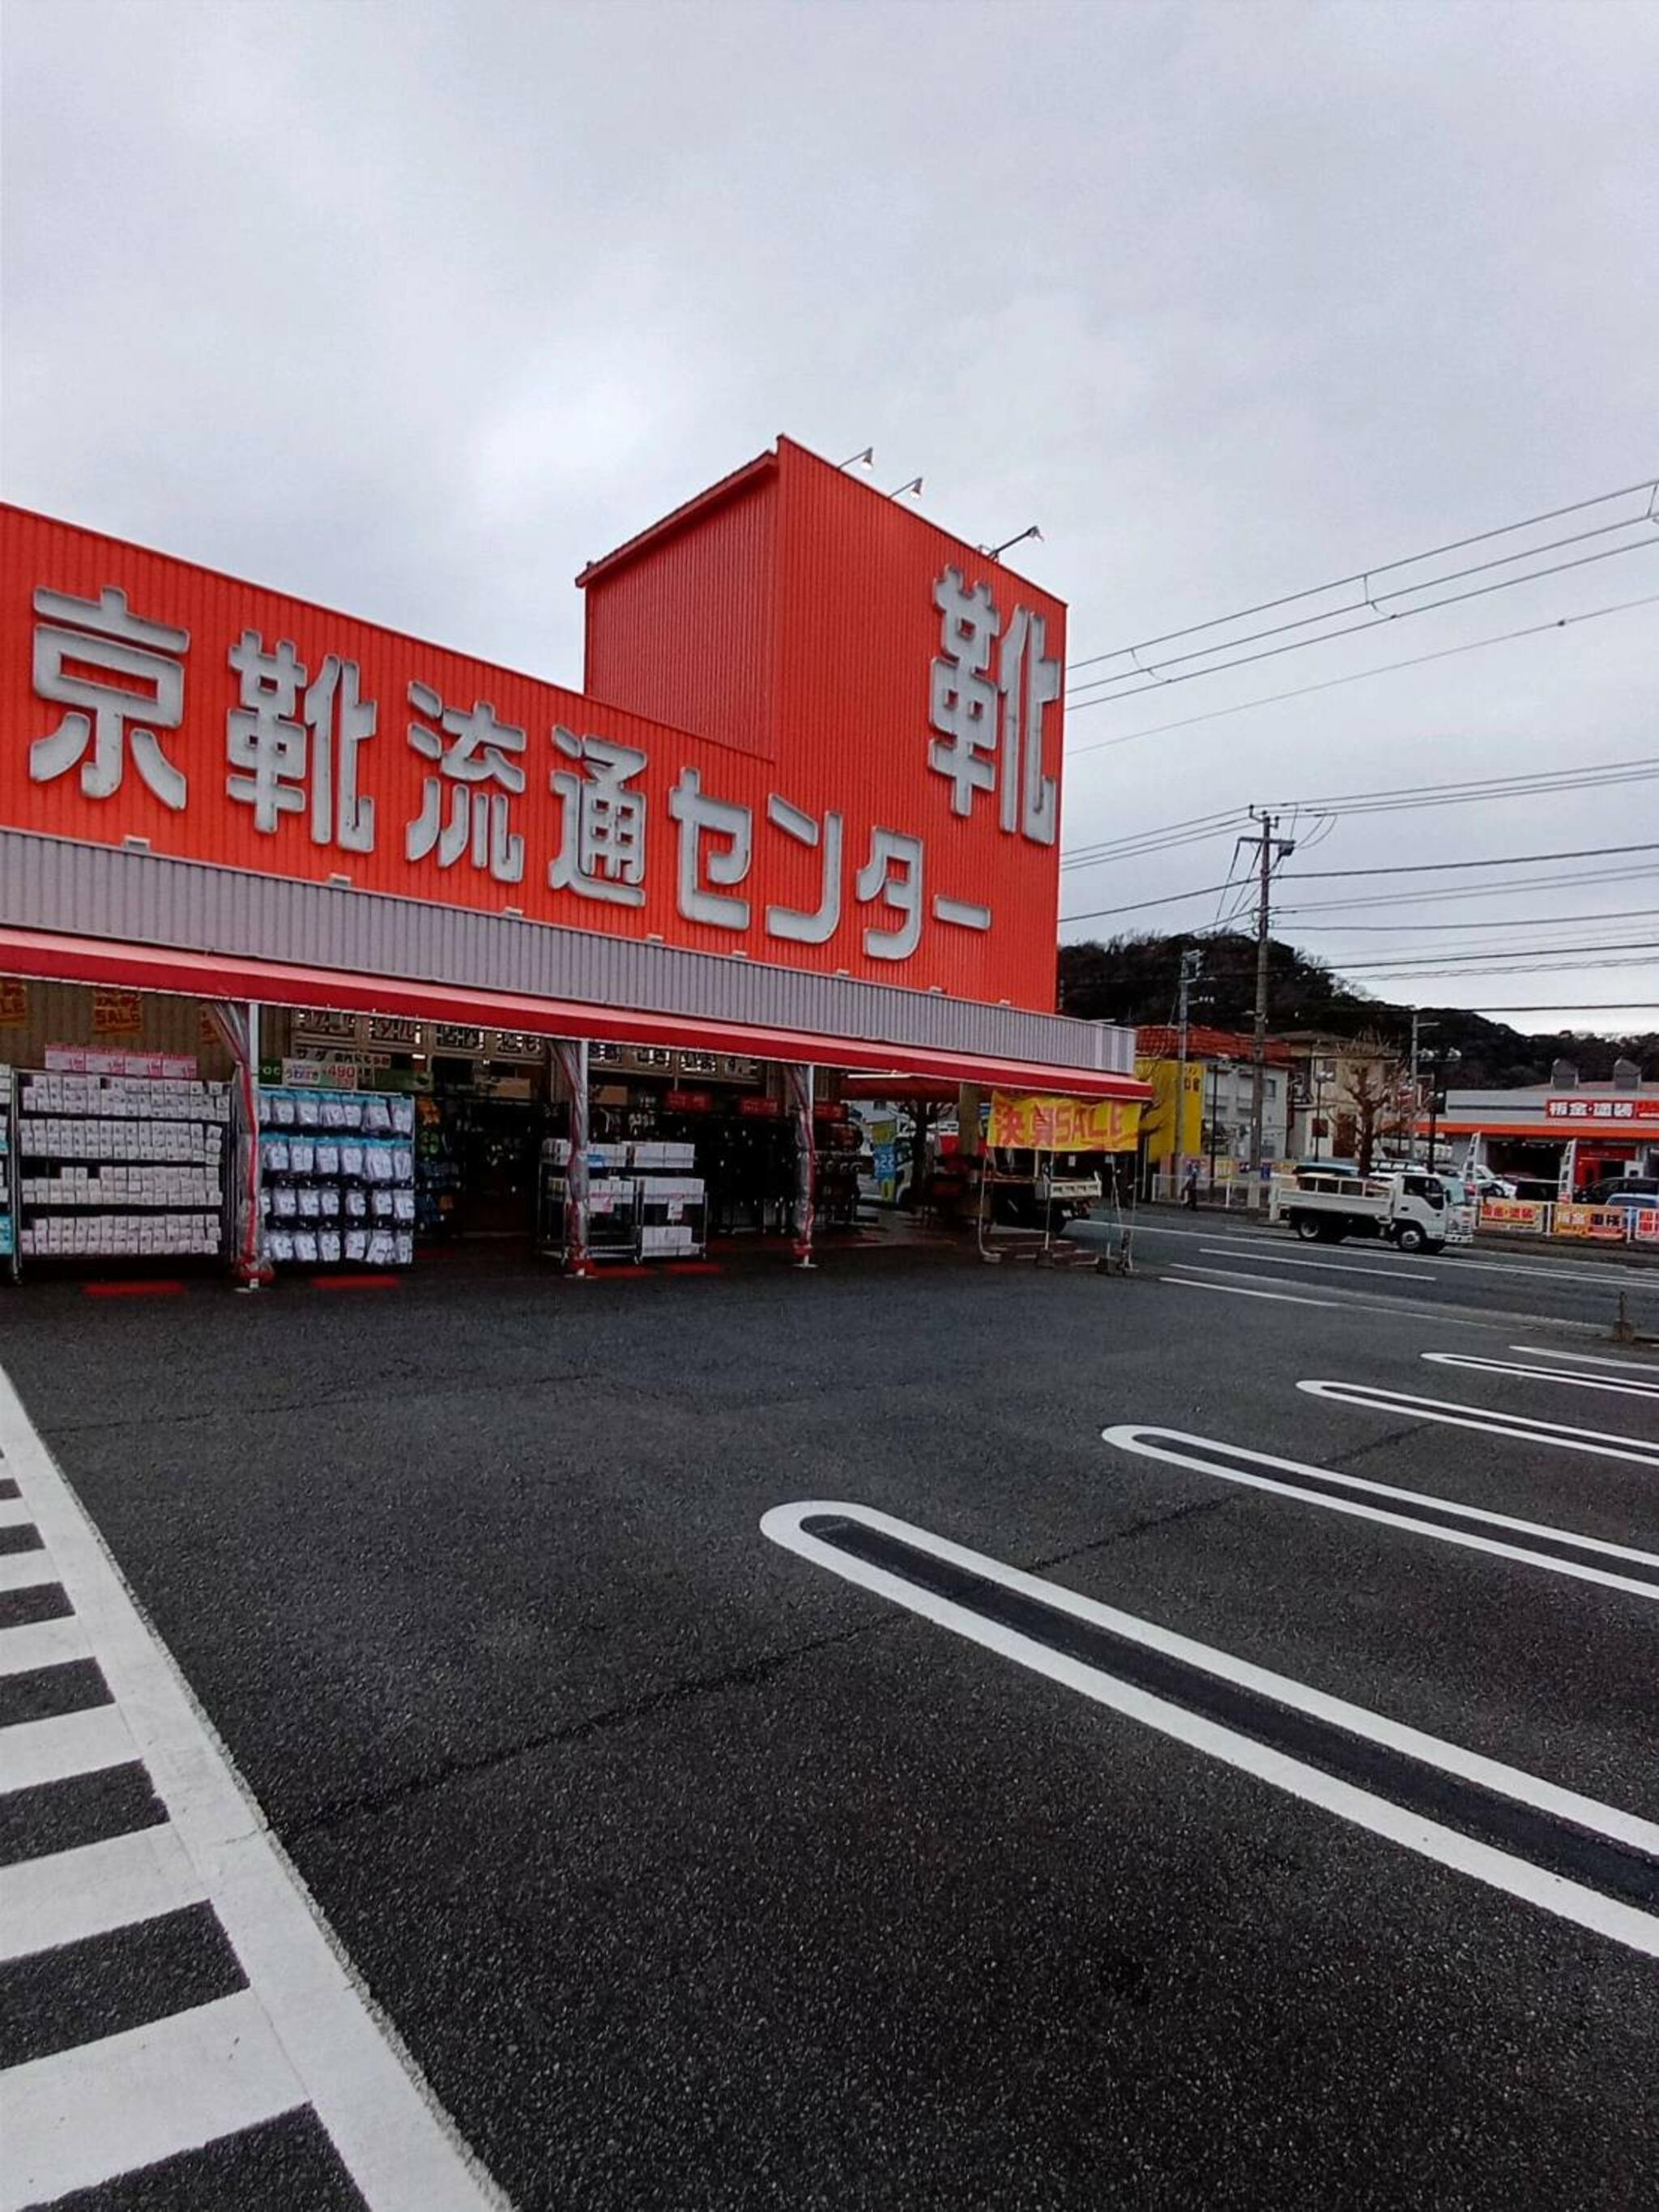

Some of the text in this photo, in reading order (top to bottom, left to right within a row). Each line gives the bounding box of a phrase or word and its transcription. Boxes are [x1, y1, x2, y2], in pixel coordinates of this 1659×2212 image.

[30, 584, 992, 962] 京靴流通センター
[928, 564, 1061, 845] 靴
[96, 1010, 141, 1027] SALE
